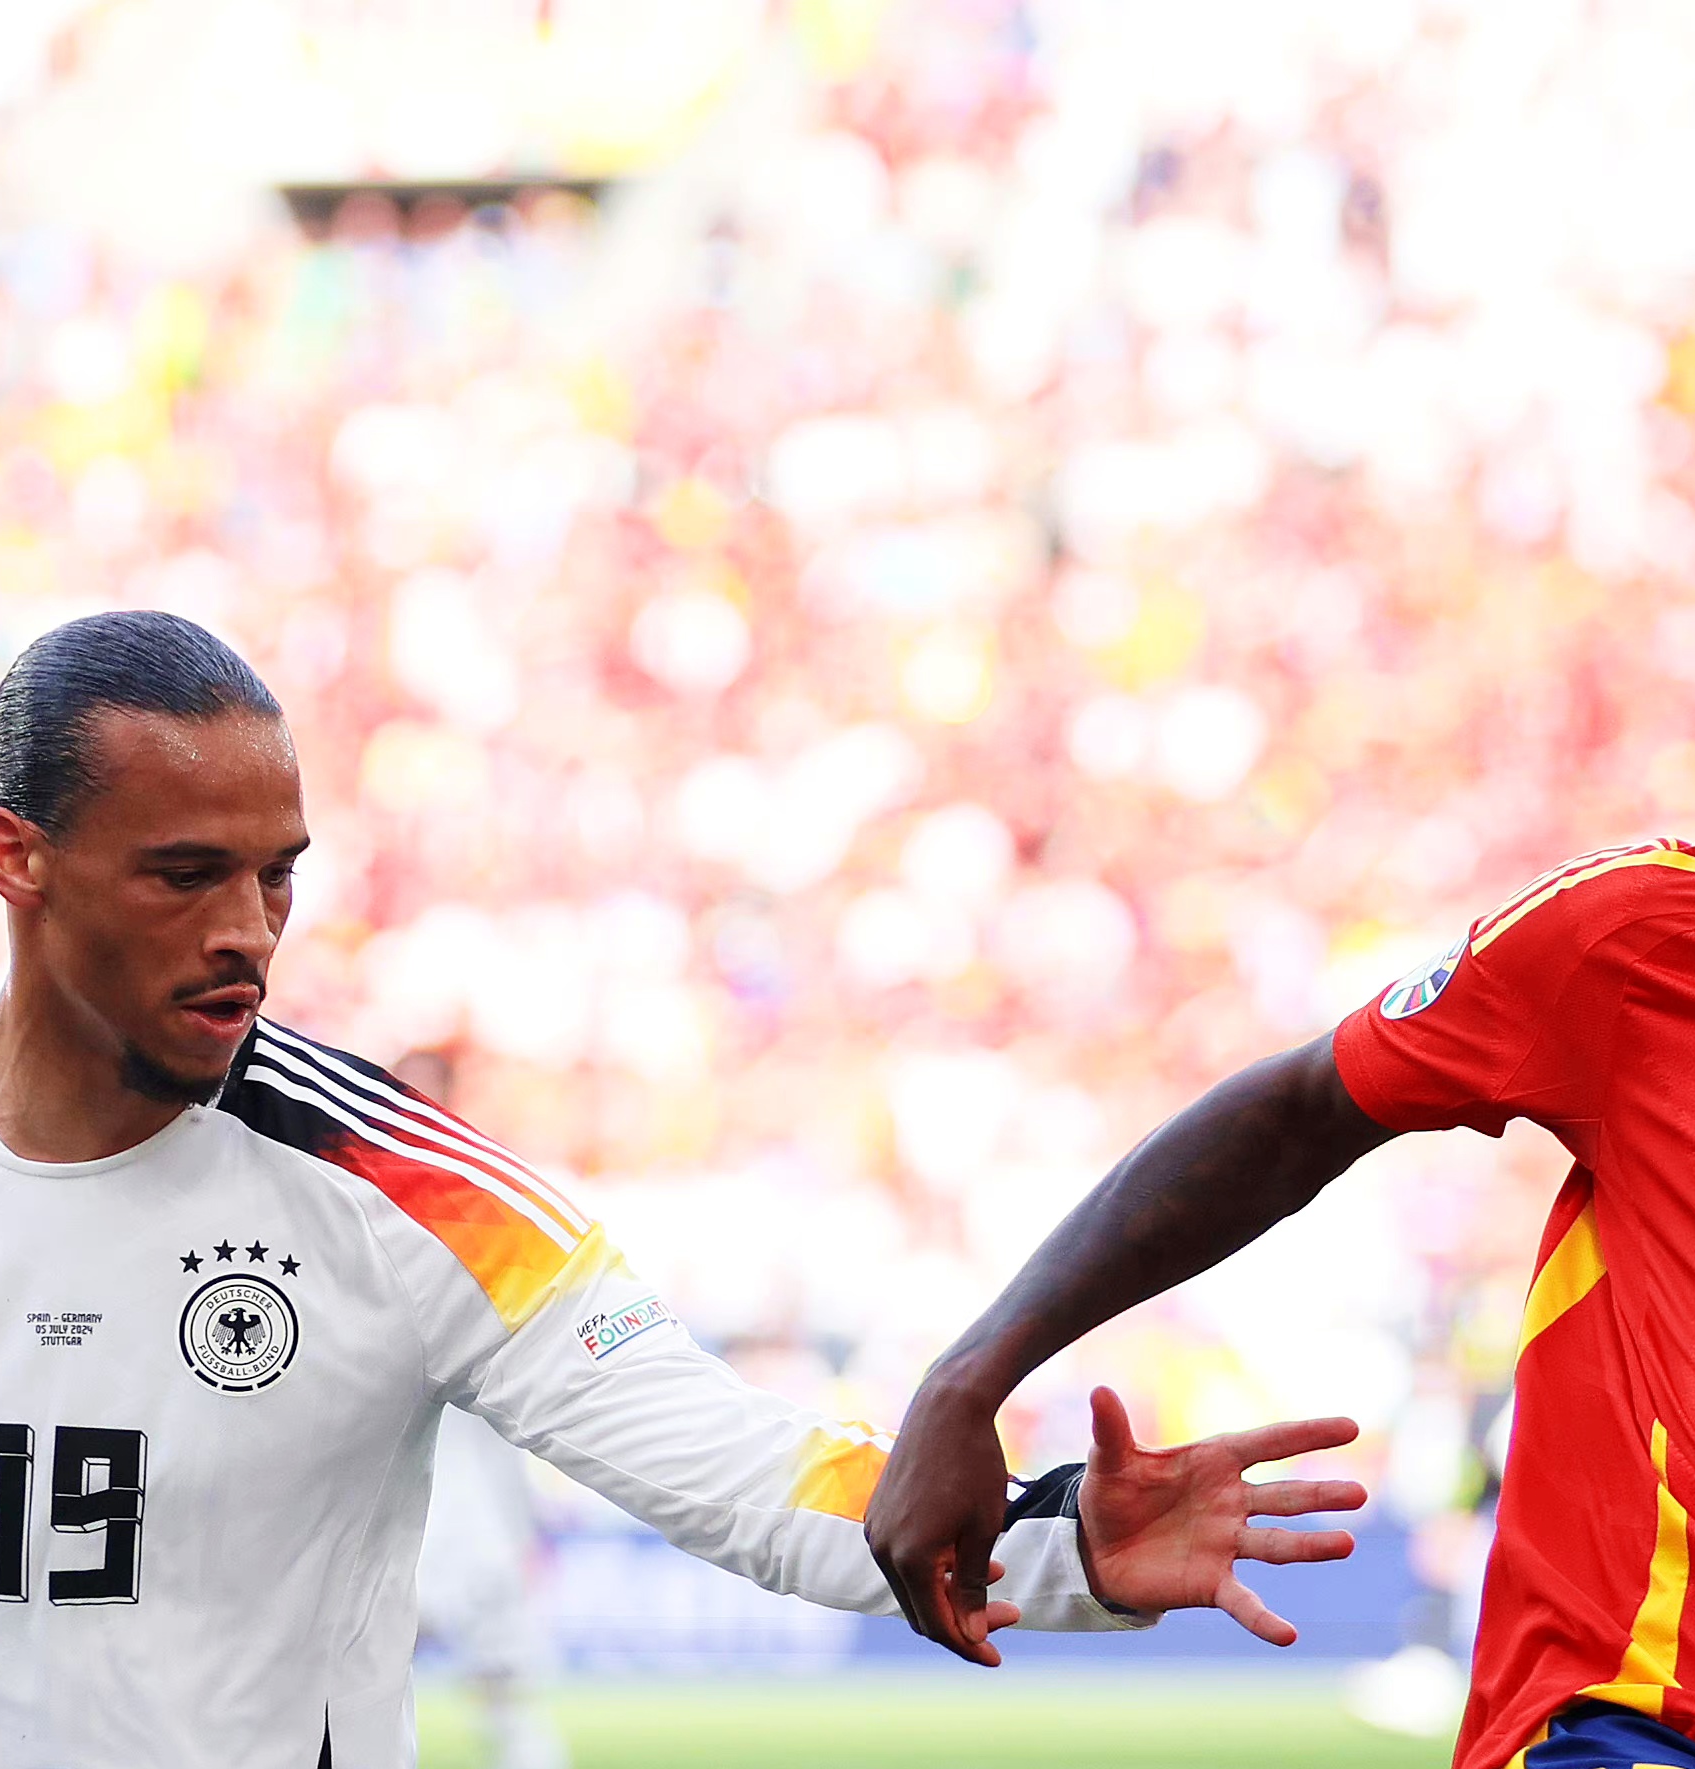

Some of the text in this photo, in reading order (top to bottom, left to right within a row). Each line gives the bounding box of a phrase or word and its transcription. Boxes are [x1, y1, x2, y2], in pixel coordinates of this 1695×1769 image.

[206, 1288, 273, 1310] DEUTSCHER
[26, 1313, 51, 1323] SPAIN
[61, 1313, 103, 1323] GERMANY
[35, 1324, 93, 1334] 05 JULY 2024
[577, 1313, 608, 1338] UEFA
[198, 1345, 280, 1376] FUSSBALL-BUND
